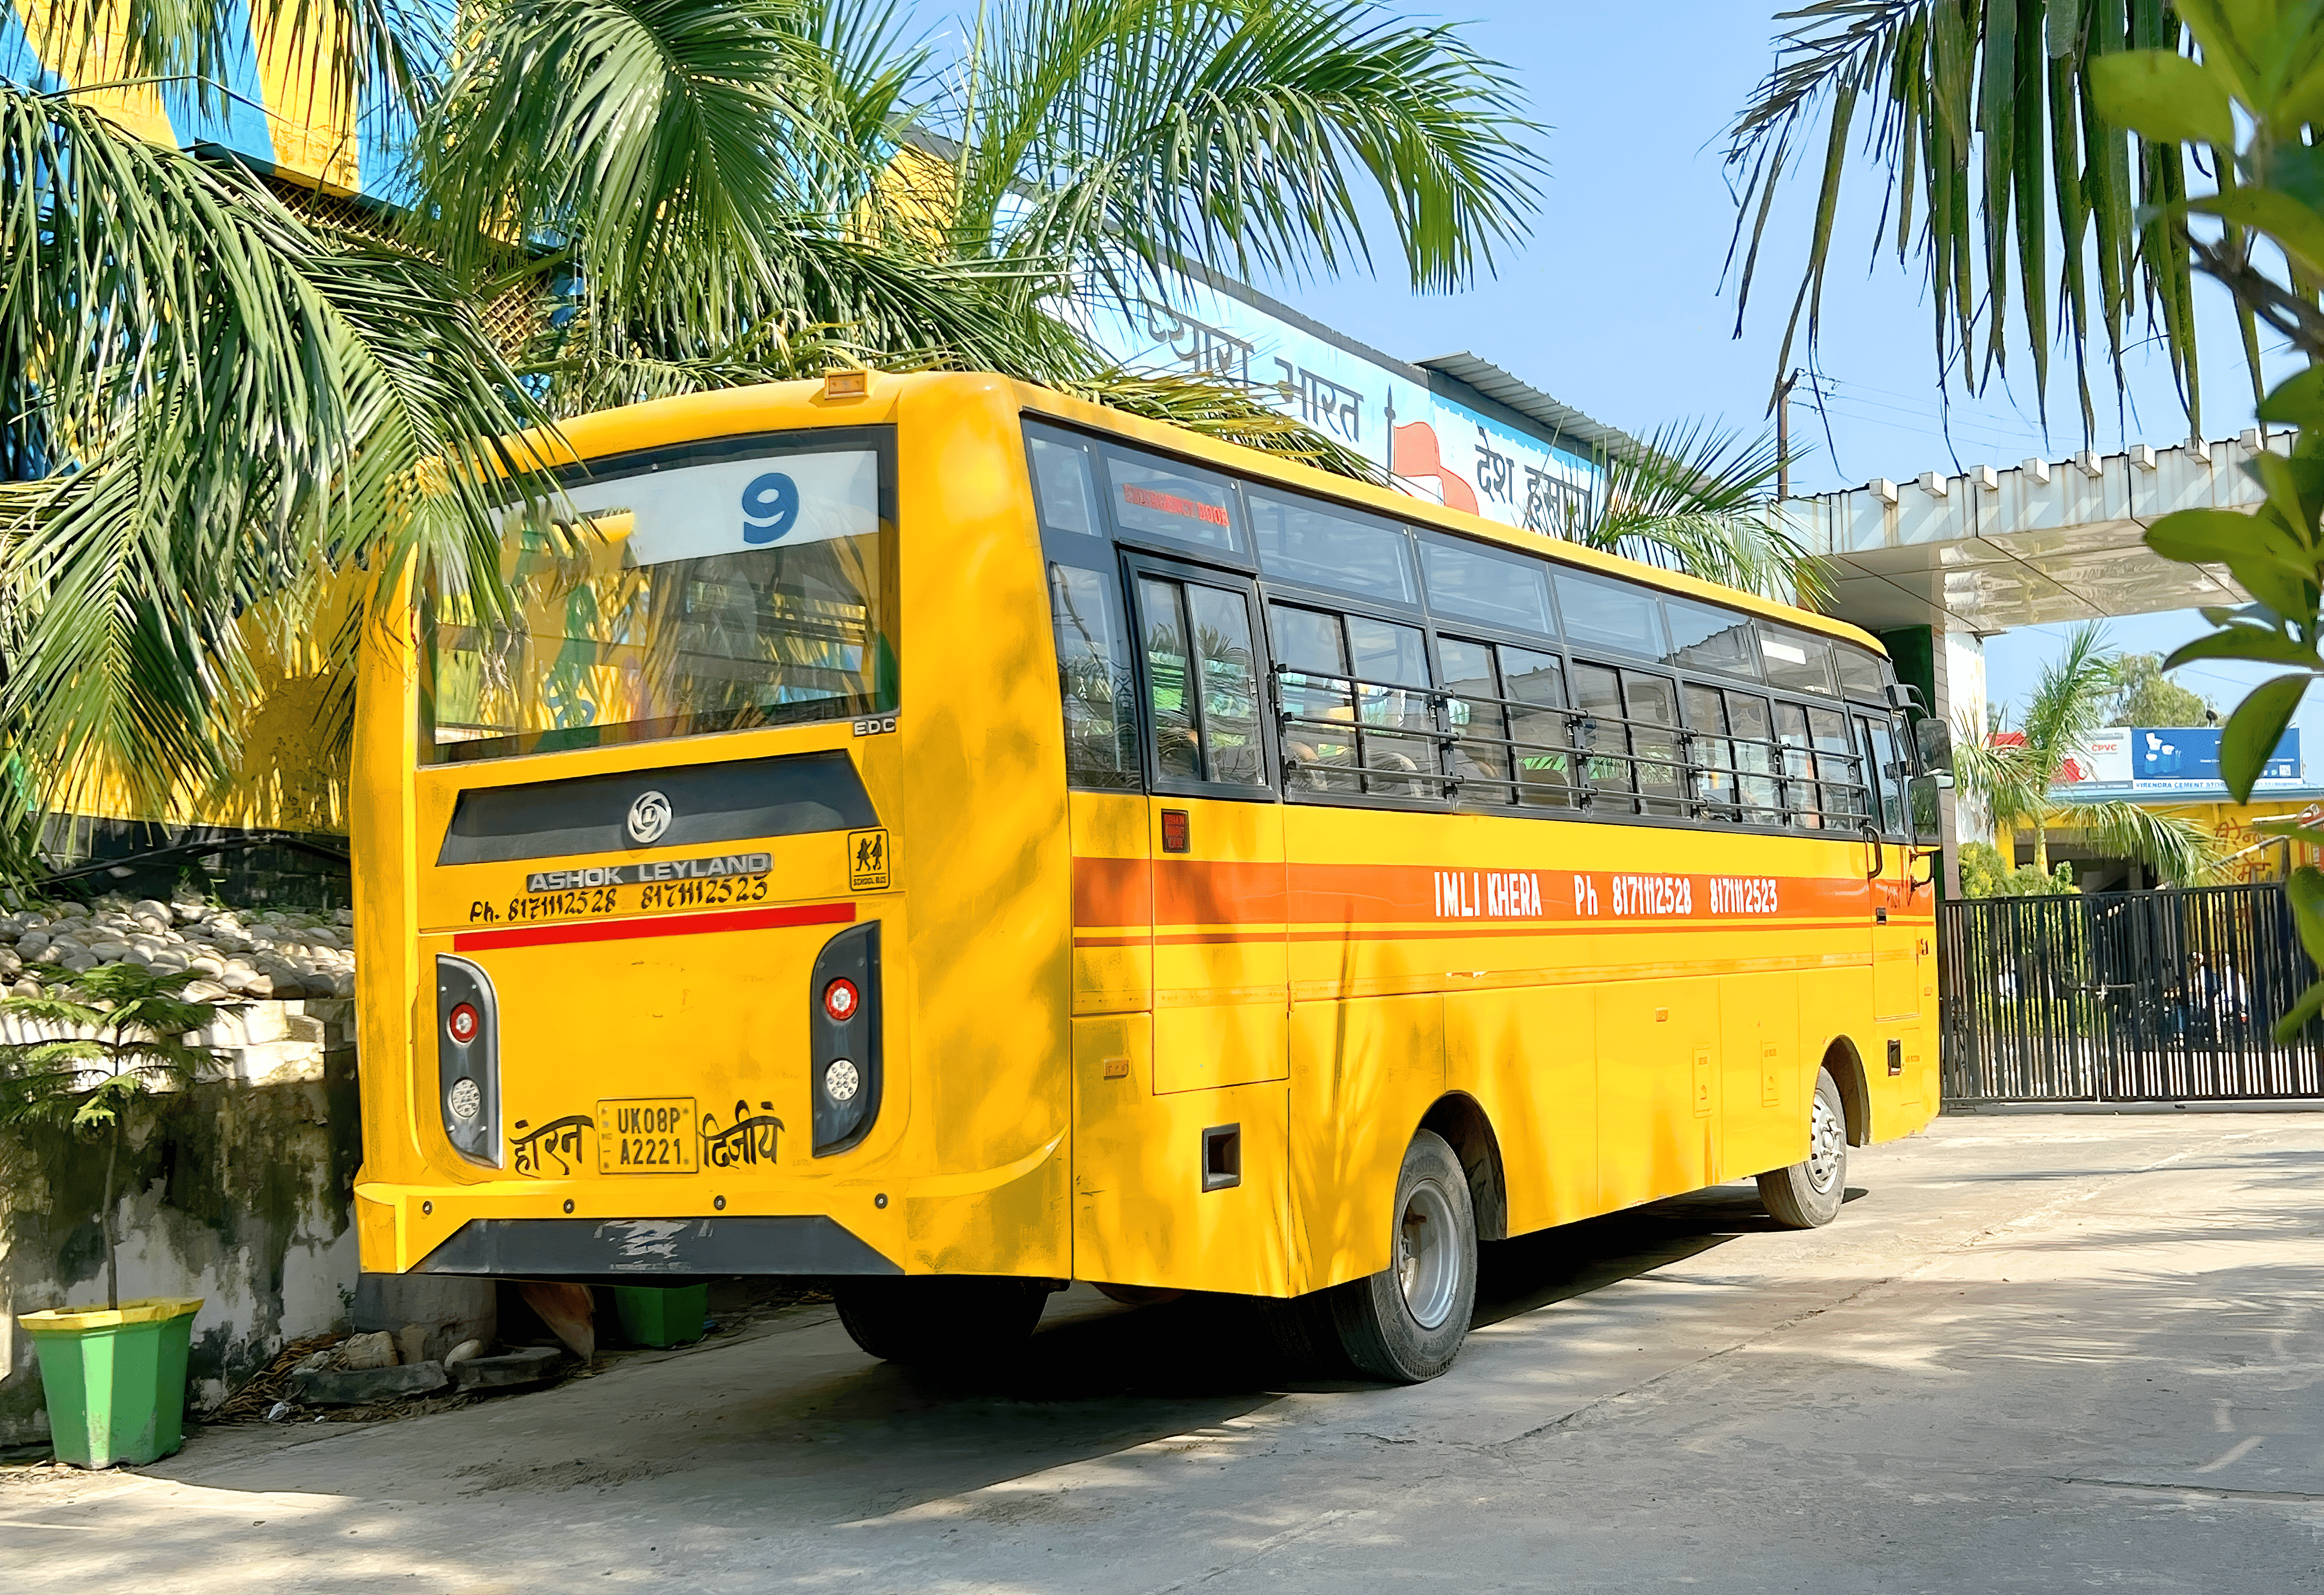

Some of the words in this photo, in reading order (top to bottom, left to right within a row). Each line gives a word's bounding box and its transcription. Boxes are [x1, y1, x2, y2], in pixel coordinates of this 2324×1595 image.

[1274, 356, 1365, 443] भारत
[1474, 425, 1515, 506] देश
[741, 472, 799, 545] 9
[854, 718, 896, 736] EDC
[2091, 743, 2118, 752] CPVC
[528, 866, 624, 893] ASHOK
[638, 853, 769, 882] LEYLAND
[1434, 871, 1481, 917] IMLI
[1487, 872, 1543, 917] KHERA
[1574, 874, 1598, 916] Ph
[1612, 875, 1692, 916] 8171112528
[1710, 878, 1778, 914] 8171112523
[469, 901, 501, 923] Ph.
[508, 886, 618, 923] 8171112528
[640, 872, 771, 910] 8171112523
[617, 1107, 681, 1135] UK08P
[508, 1114, 596, 1179] होरन
[620, 1138, 681, 1165] A2221
